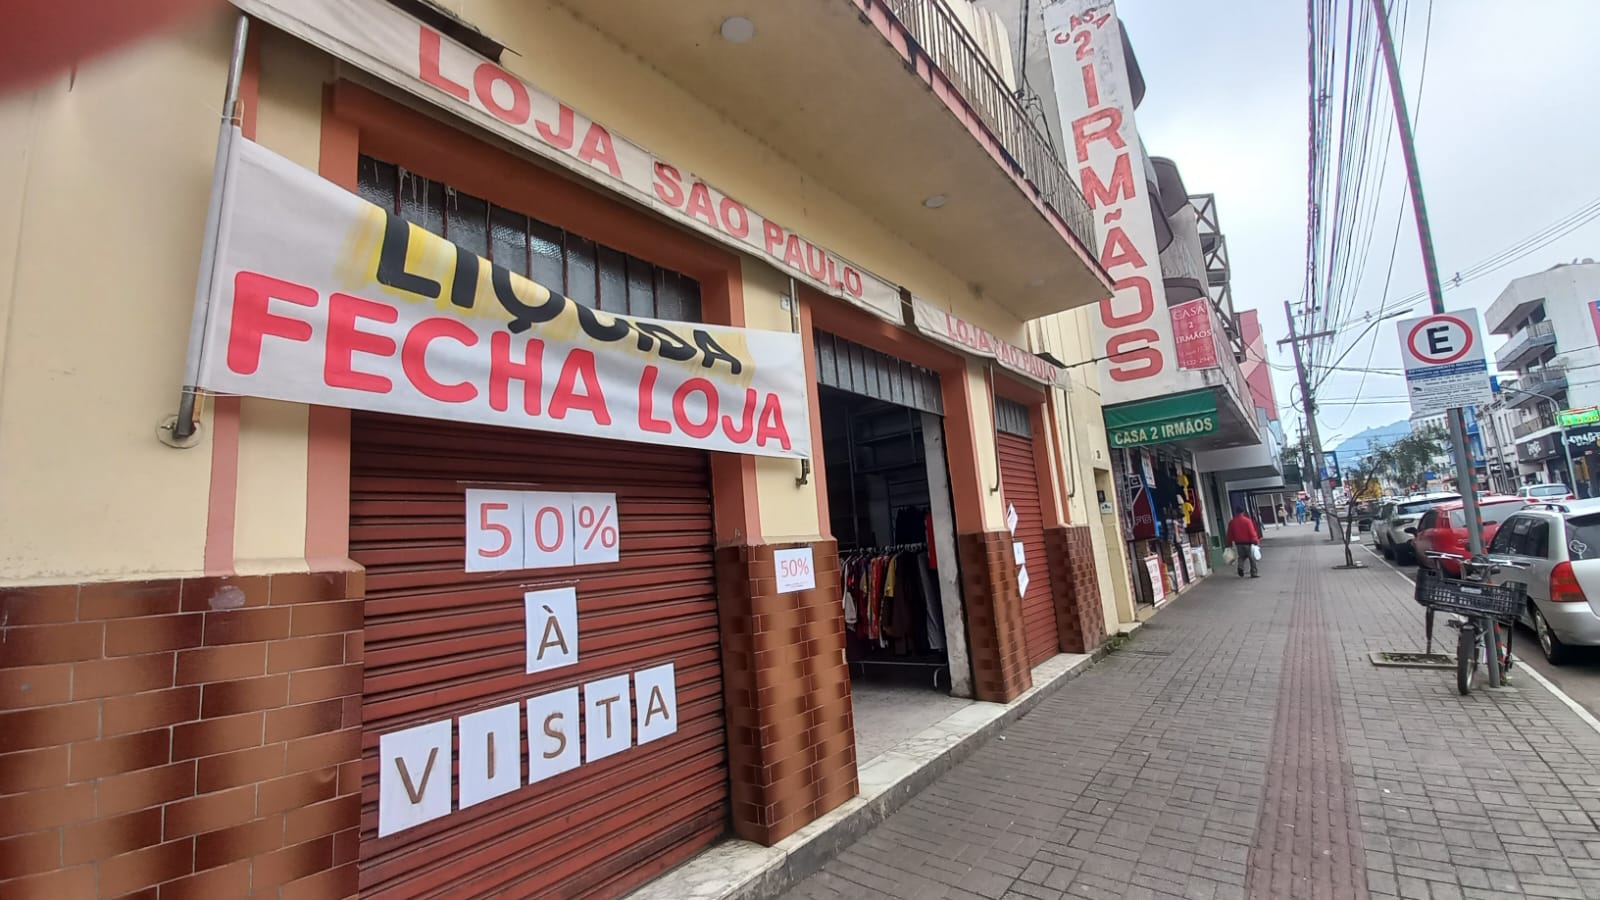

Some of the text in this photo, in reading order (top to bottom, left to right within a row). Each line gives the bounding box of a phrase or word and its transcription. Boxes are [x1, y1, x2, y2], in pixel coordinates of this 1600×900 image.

[1054, 8, 1111, 44] CASA
[1074, 30, 1094, 61] 2
[419, 25, 623, 179] LOJA
[762, 218, 863, 298] PAULO
[1071, 62, 1163, 382] IRMÃOS
[945, 312, 991, 350] LOJA
[1173, 305, 1205, 320] CASA
[1188, 321, 1194, 329] 2
[1427, 326, 1453, 354] E
[227, 271, 791, 450] FECHA LOJA
[1115, 417, 1213, 444] CASA 2 IRMÃOS
[478, 503, 617, 558] 50%
[780, 556, 809, 578] 50%
[536, 605, 569, 660] À
[394, 685, 670, 805] VISTA
